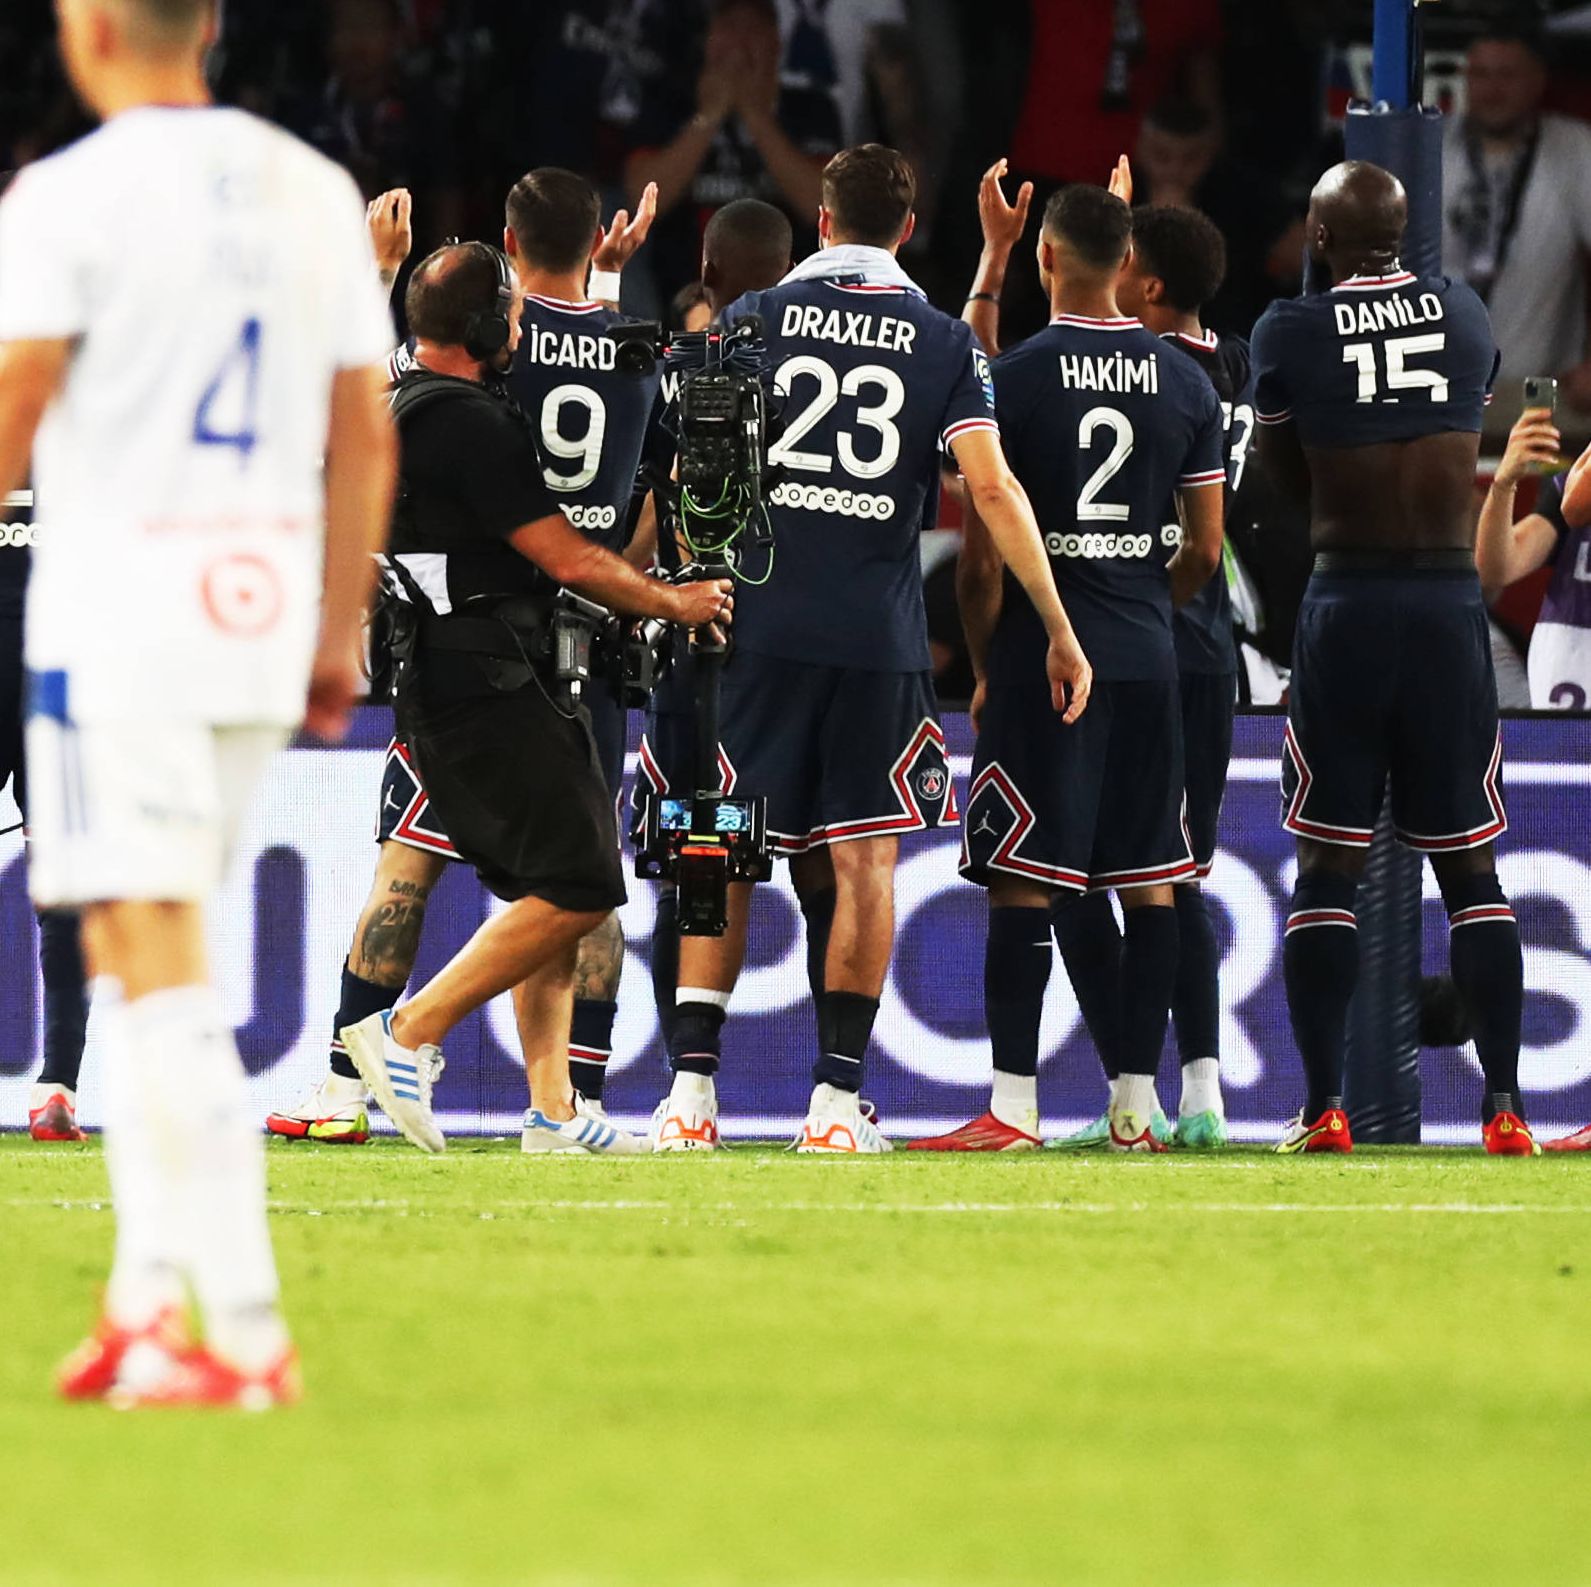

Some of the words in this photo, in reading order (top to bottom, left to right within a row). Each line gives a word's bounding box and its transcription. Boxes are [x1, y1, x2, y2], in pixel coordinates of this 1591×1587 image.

[780, 304, 916, 355] DRAXLER
[1342, 332, 1449, 404] 15
[186, 307, 269, 478] 4
[540, 384, 607, 492] 9
[767, 356, 905, 480] 23
[1076, 406, 1135, 521] 2
[1046, 532, 1153, 559] ooredoo
